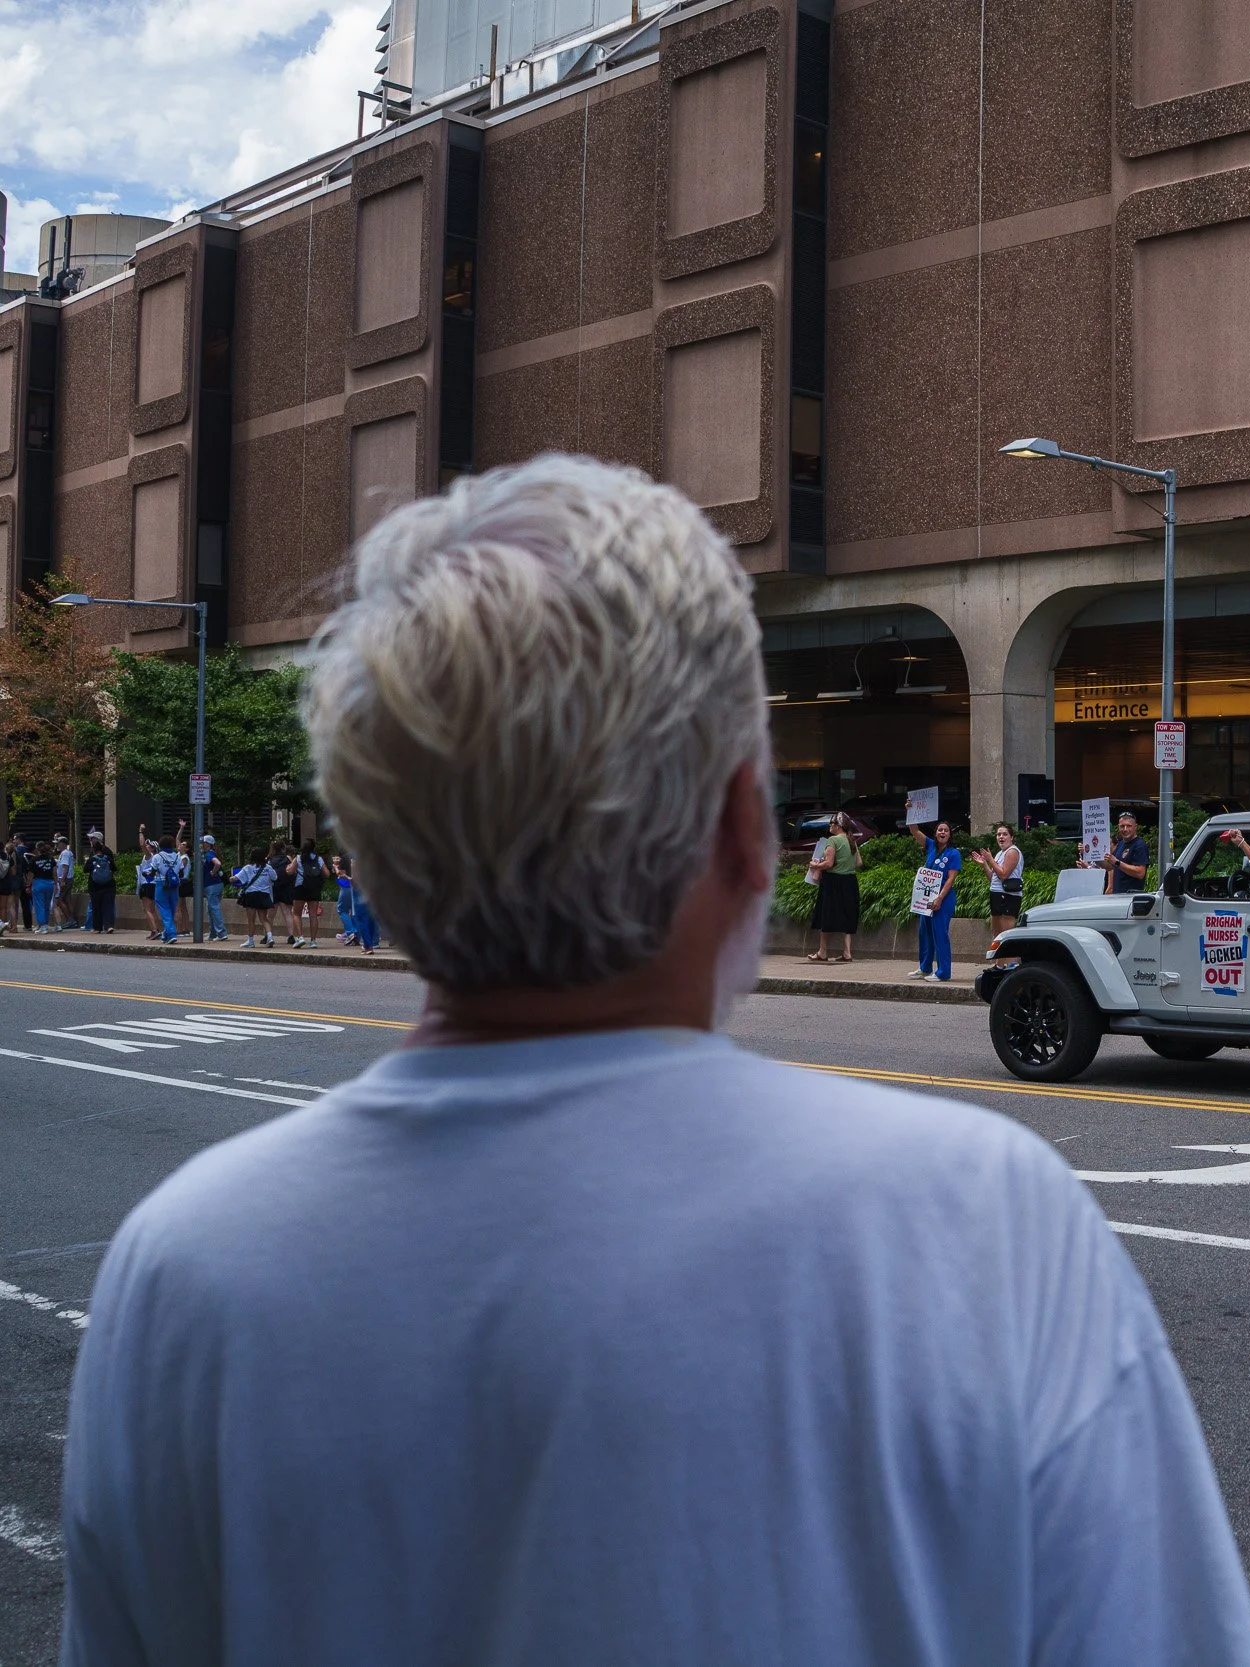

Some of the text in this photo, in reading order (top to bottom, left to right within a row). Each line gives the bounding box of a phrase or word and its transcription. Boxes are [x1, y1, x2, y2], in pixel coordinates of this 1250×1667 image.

[1075, 702, 1149, 719] Entrance
[919, 868, 942, 879] LOCKED
[923, 877, 935, 885] OUT
[1205, 916, 1242, 928] BRIGHAM
[1208, 930, 1239, 941] NURSES
[1204, 946, 1243, 964] LOCKED
[1133, 970, 1157, 982] Jeep
[1205, 968, 1241, 984] OUT
